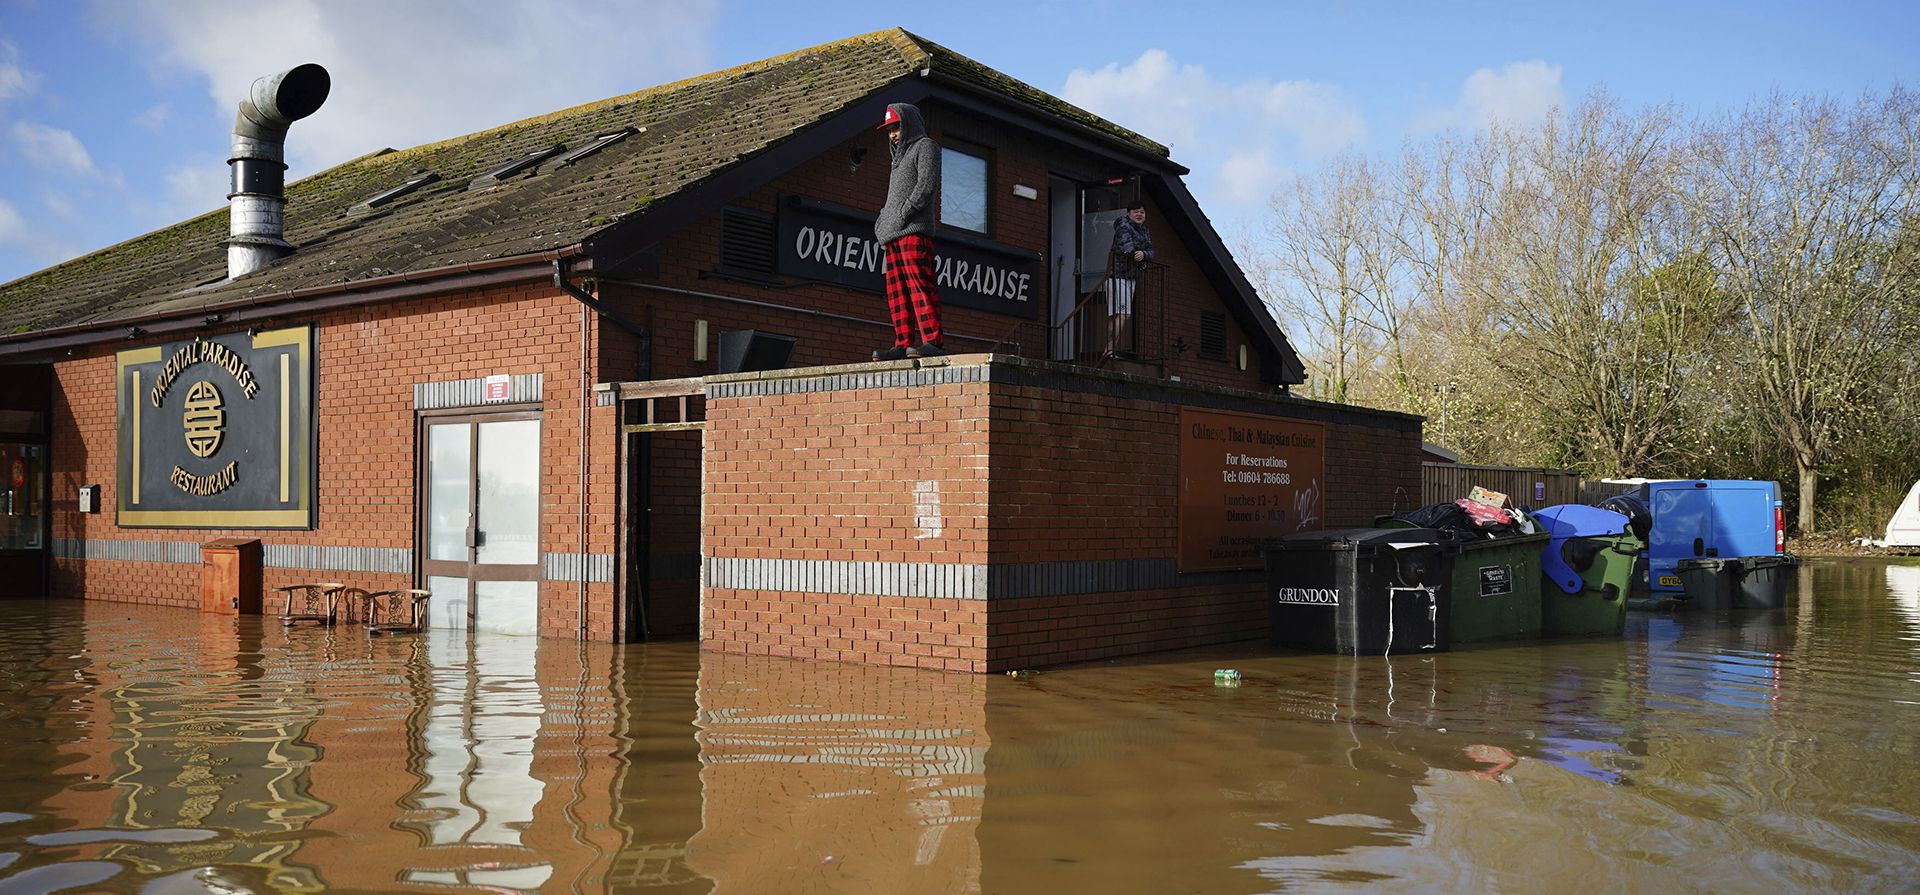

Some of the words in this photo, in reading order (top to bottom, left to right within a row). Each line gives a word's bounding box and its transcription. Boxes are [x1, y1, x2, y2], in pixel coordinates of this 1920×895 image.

[151, 342, 198, 407] ORIENTAL
[201, 341, 256, 399] PARADISE
[1192, 424, 1225, 441] Chinese,
[1228, 427, 1245, 442] Thai
[1247, 431, 1253, 443] &
[1256, 430, 1290, 448] Malaysian
[1292, 433, 1316, 448] Cuisine
[1226, 453, 1239, 465] For
[1241, 454, 1287, 468] Reservations
[170, 460, 235, 495] RESTAURANT
[1223, 470, 1236, 482] Tel:
[1238, 472, 1260, 483] 01604
[1263, 473, 1290, 484] 786688
[1224, 494, 1255, 506] Lunches
[1258, 496, 1266, 506] 12
[1274, 496, 1278, 506] 2
[1228, 511, 1251, 521] Dinner
[1279, 588, 1339, 603] GRUNDON
